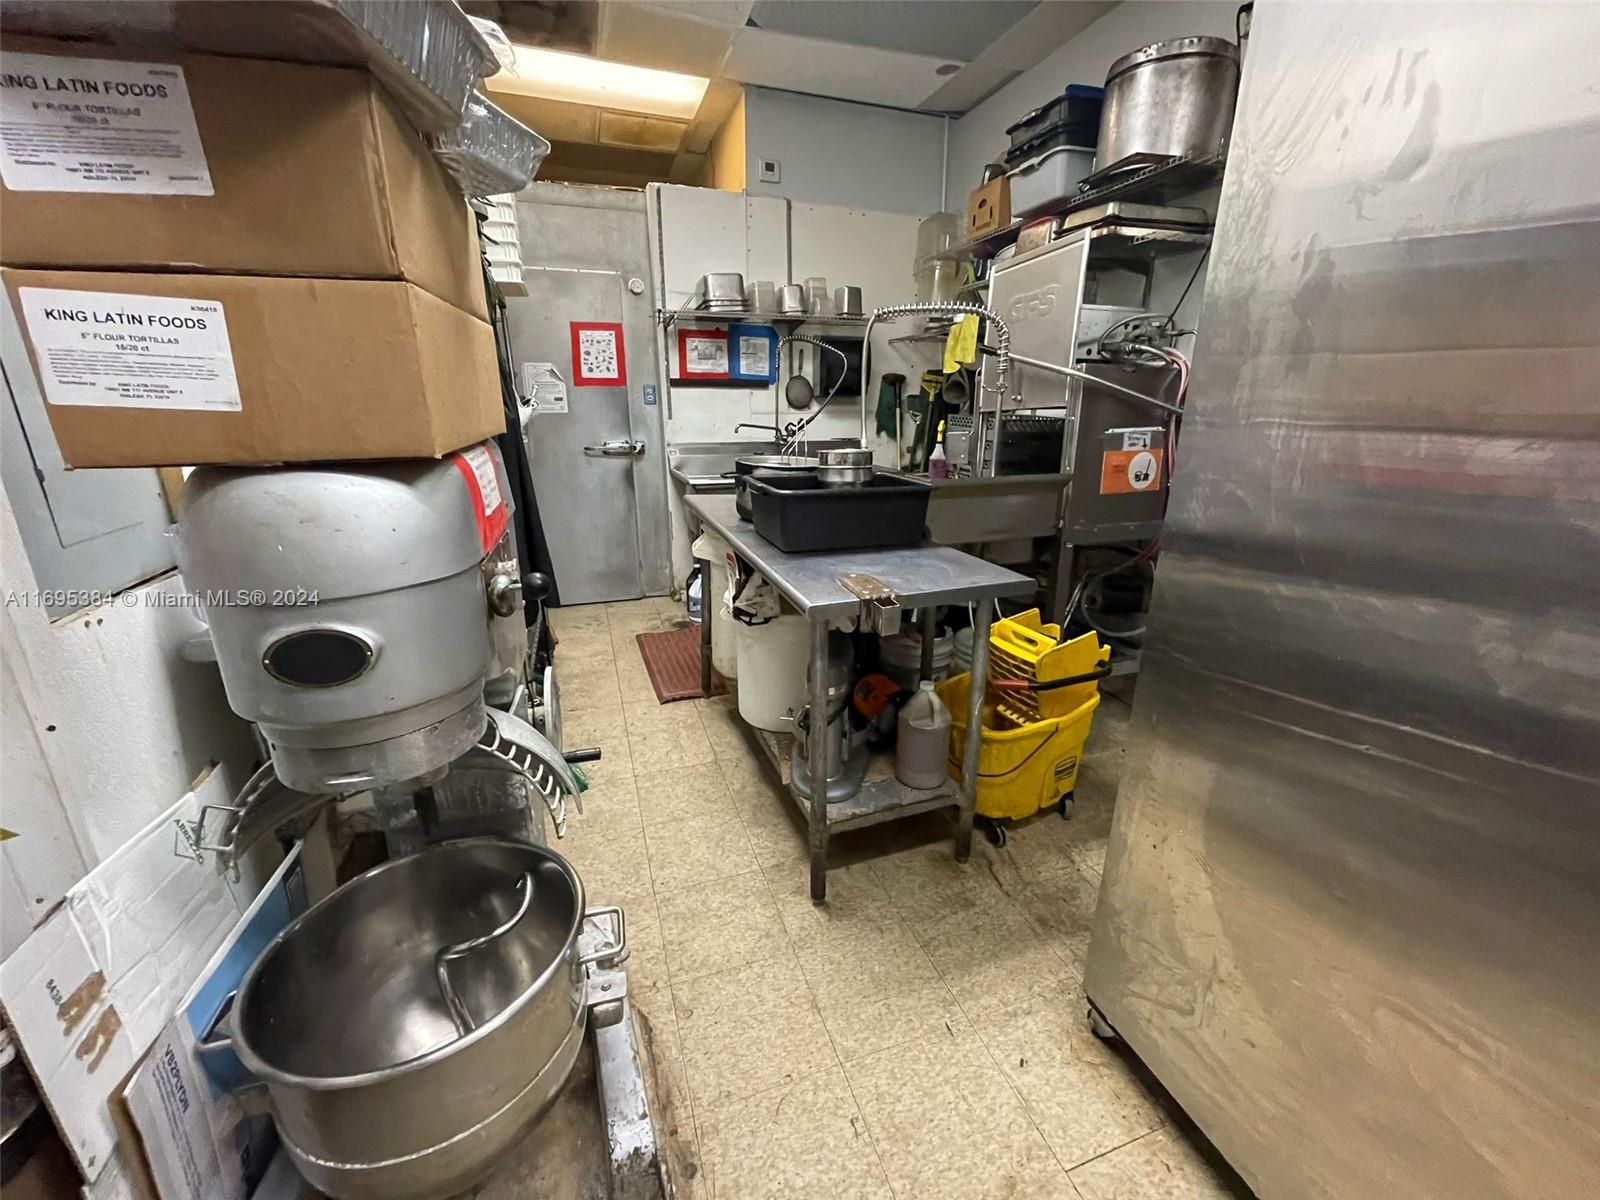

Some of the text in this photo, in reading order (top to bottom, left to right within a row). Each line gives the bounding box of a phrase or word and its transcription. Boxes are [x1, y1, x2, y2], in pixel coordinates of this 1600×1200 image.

[42, 77, 99, 94] LATIN
[104, 81, 168, 98] FOODS
[44, 308, 208, 330] KING LATIN FOODS
[93, 333, 125, 341] FLOUR
[128, 335, 180, 345] TORTILLAS
